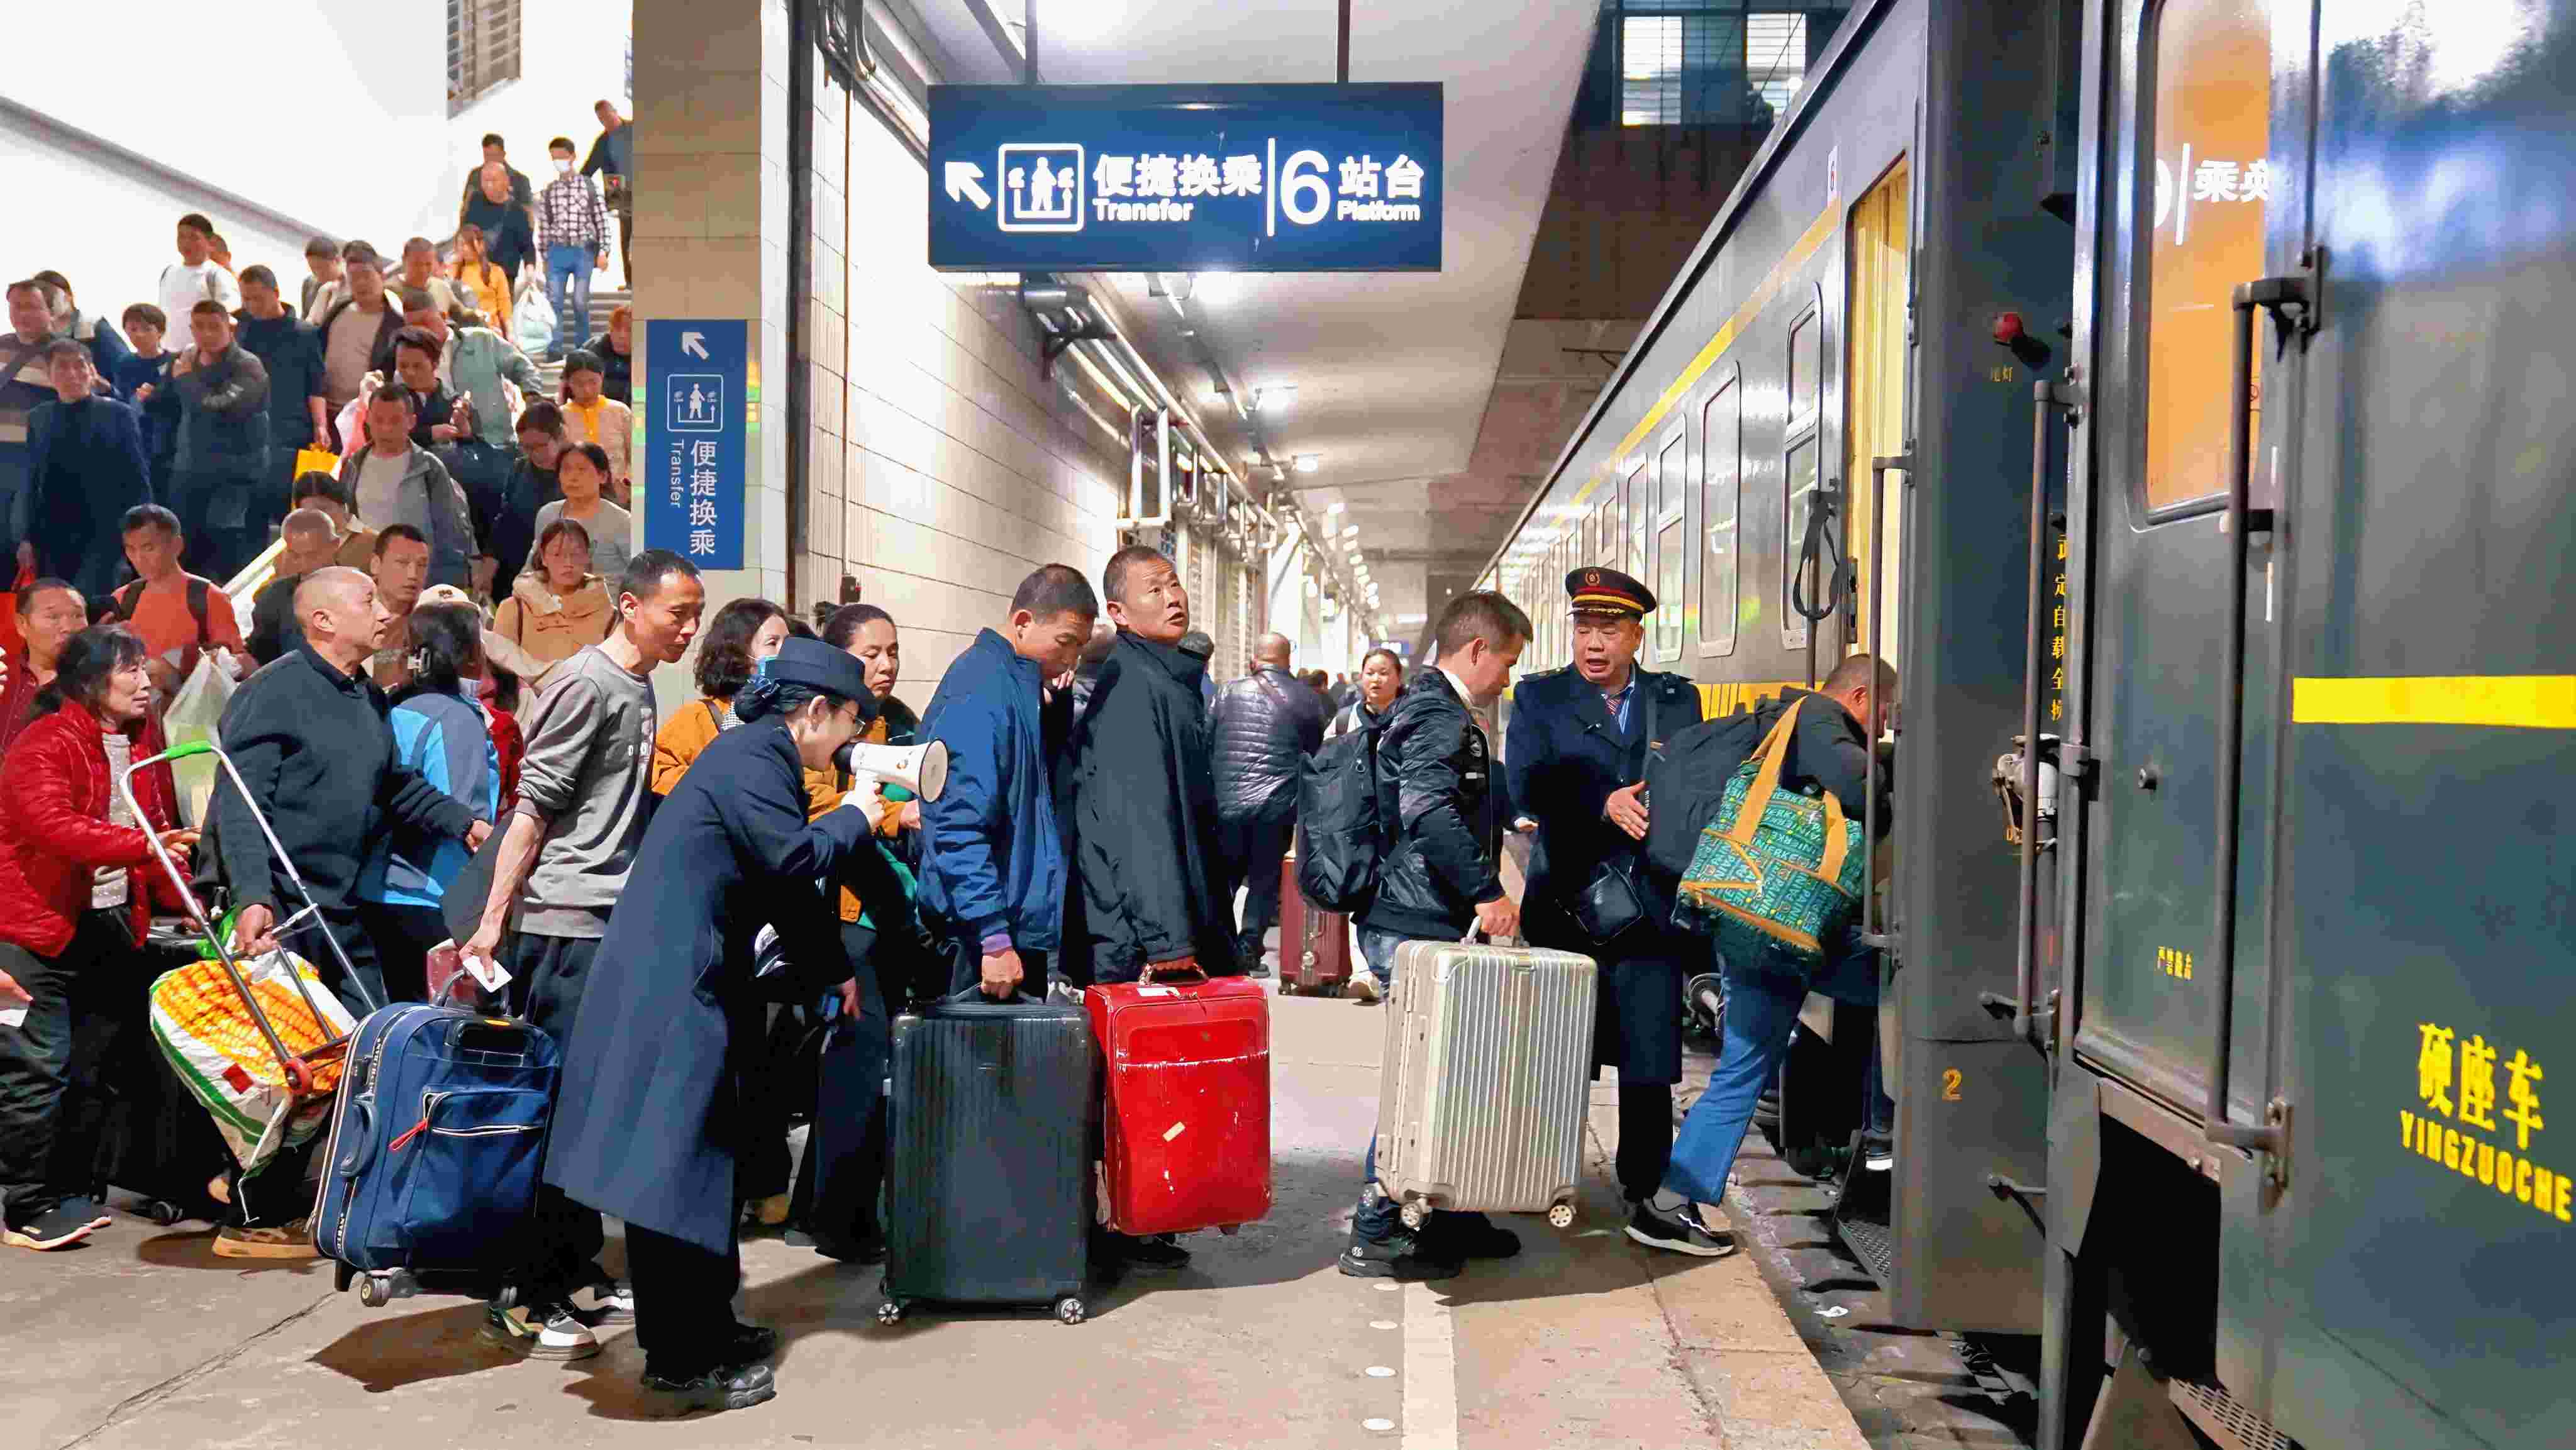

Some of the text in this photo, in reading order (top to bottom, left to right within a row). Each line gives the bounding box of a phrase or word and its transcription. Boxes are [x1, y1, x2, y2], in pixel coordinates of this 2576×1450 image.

[1092, 153, 1263, 197] 便捷换乘
[1280, 150, 1331, 225] 6
[1338, 154, 1424, 199] 站台
[1092, 198, 1194, 222] Transfer
[1337, 200, 1421, 221] Platform
[670, 440, 684, 509] Transfer
[690, 440, 718, 556] 便捷换乘
[1942, 1068, 1962, 1101] 2
[2418, 1022, 2544, 1151] 硬座车
[2399, 1109, 2572, 1223] YINGZUOCHE
